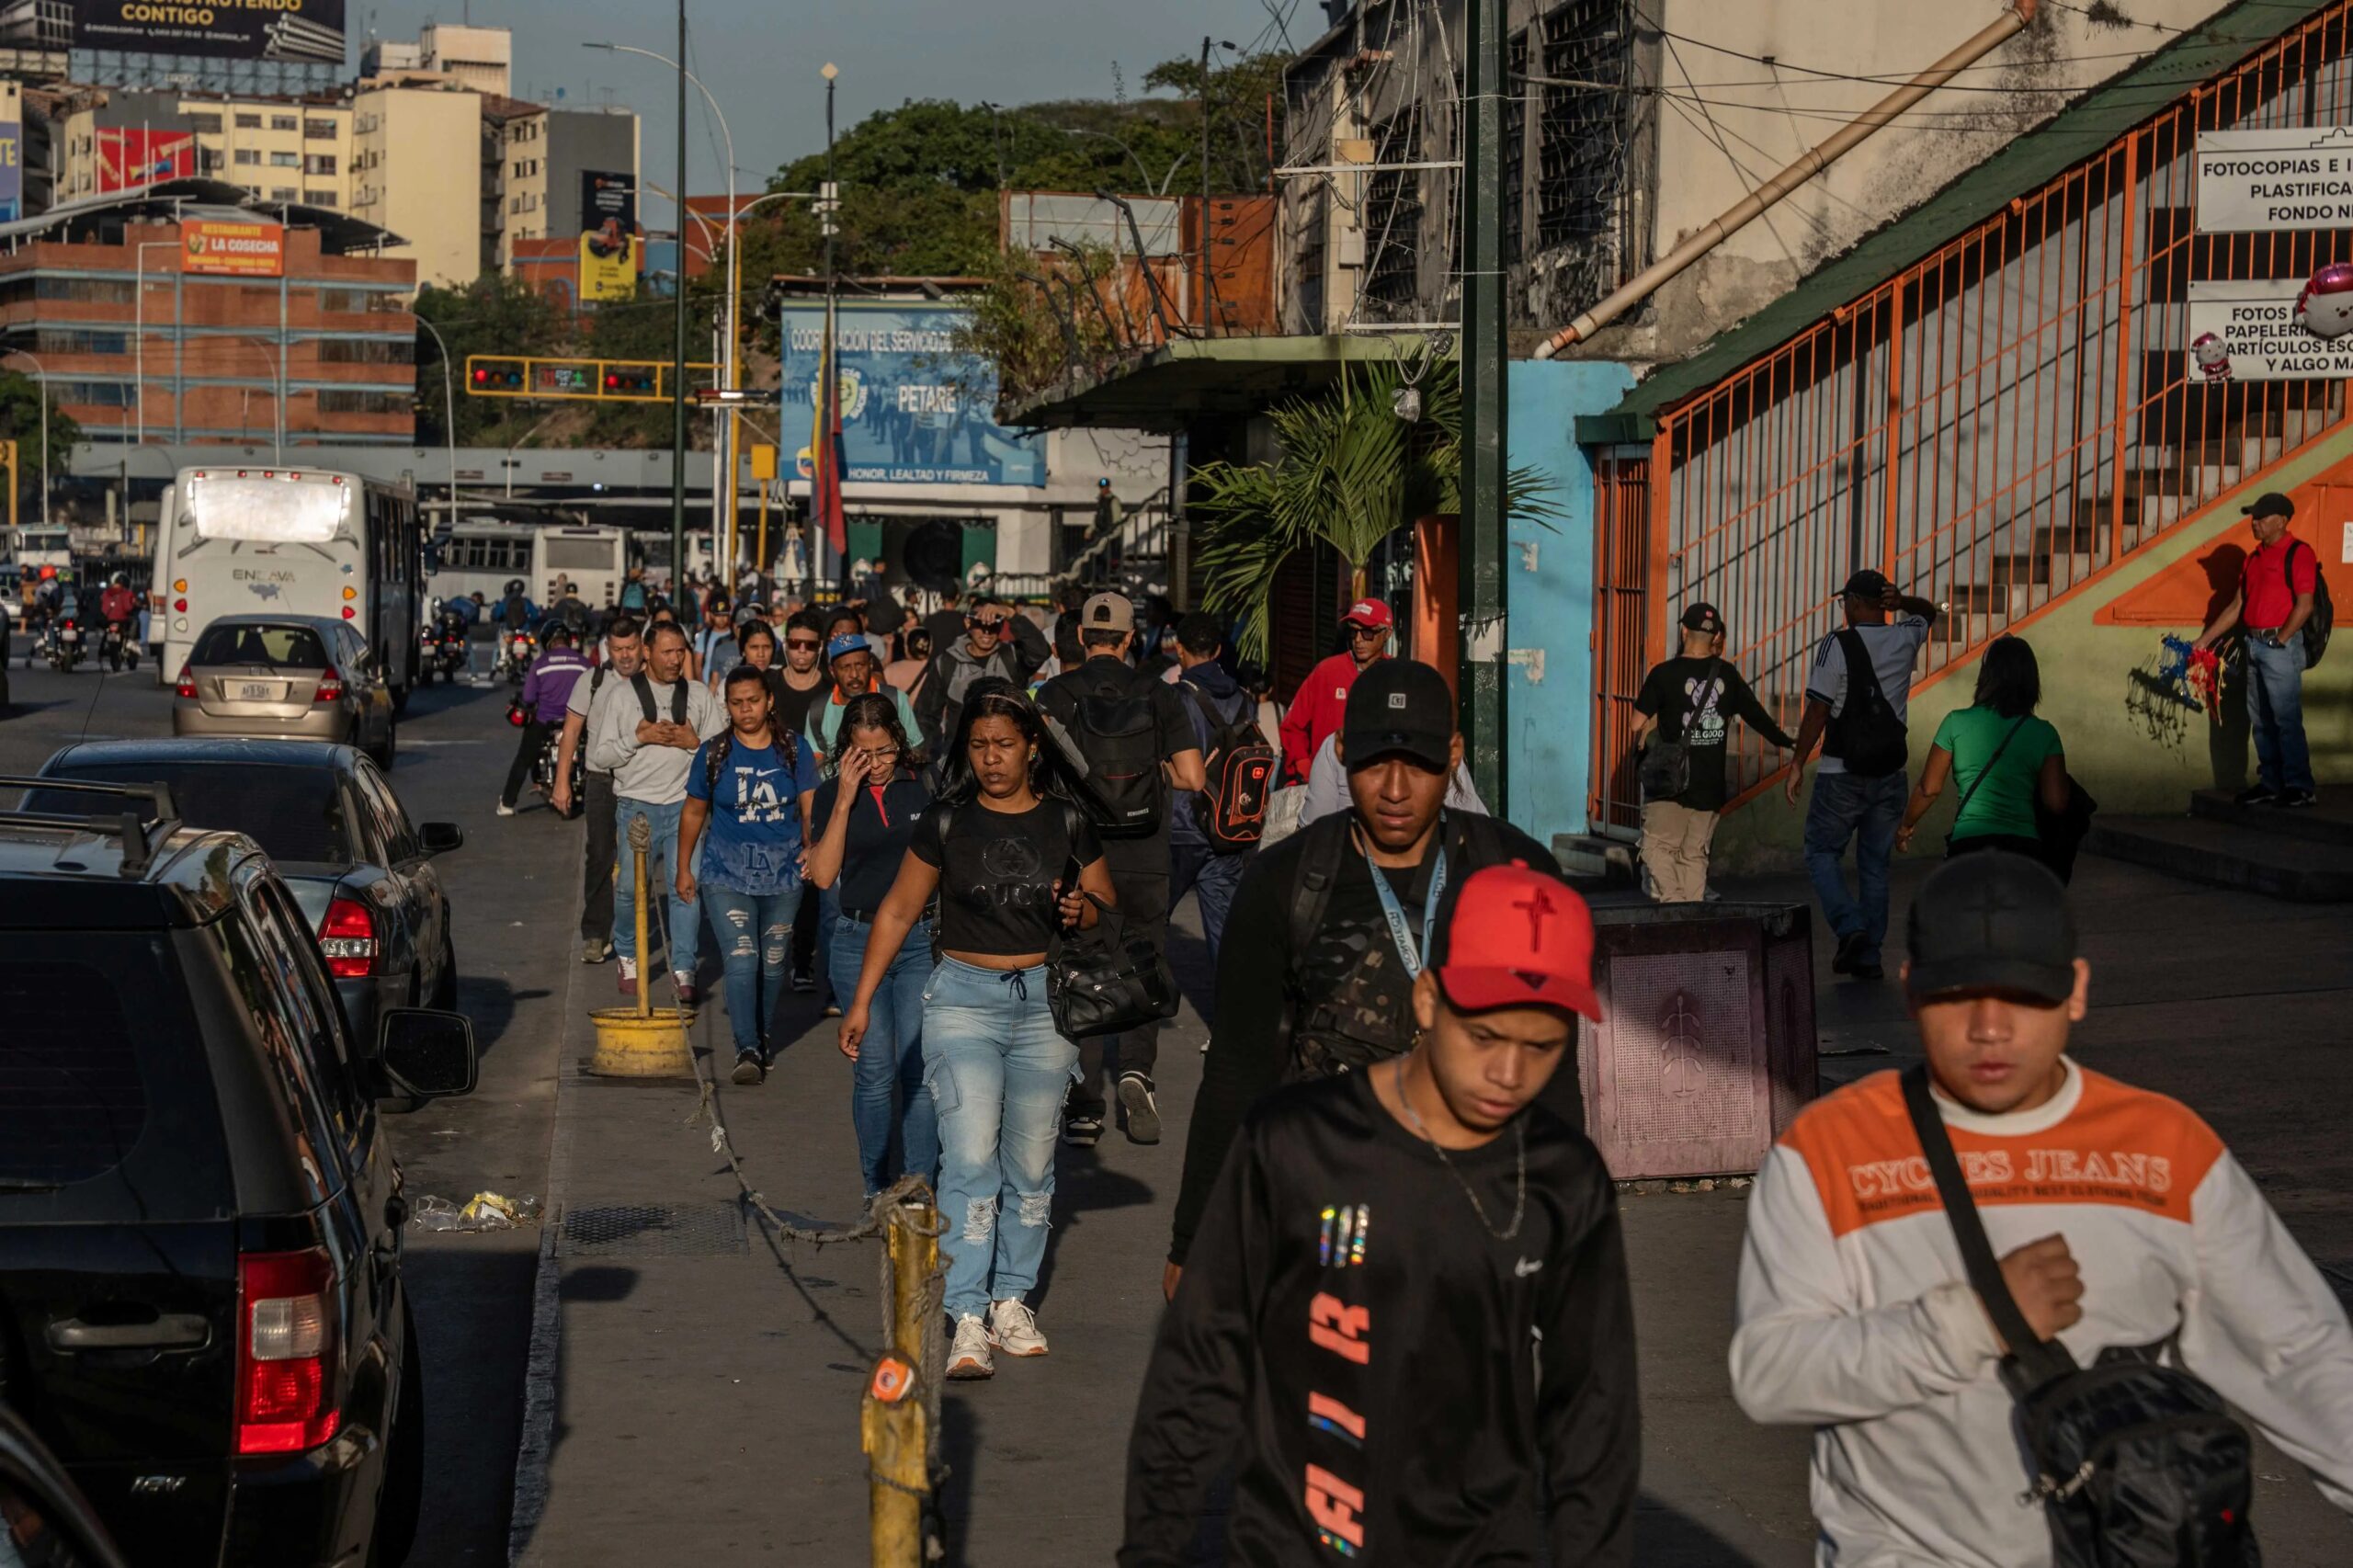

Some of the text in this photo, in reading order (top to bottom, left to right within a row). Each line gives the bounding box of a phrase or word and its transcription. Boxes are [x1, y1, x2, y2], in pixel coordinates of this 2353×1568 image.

[121, 4, 214, 25] CONTIGO
[2203, 158, 2321, 176] FOTOCOPIAS
[2328, 158, 2339, 172] E
[2268, 205, 2333, 221] FONDO
[211, 238, 279, 253] LA COSECHA
[2233, 307, 2288, 321] FOTOS
[870, 331, 889, 352] DEL
[2226, 338, 2322, 356] ARTÍCULOS
[2266, 358, 2277, 371] Y
[2281, 357, 2329, 371] ALGO
[898, 385, 957, 413] PETARE
[848, 468, 989, 483] HONOR, LEALTAD Y FIRMEZA
[1702, 729, 1724, 739] GOOD
[735, 767, 788, 824] LA
[2025, 1150, 2173, 1193] JEANS
